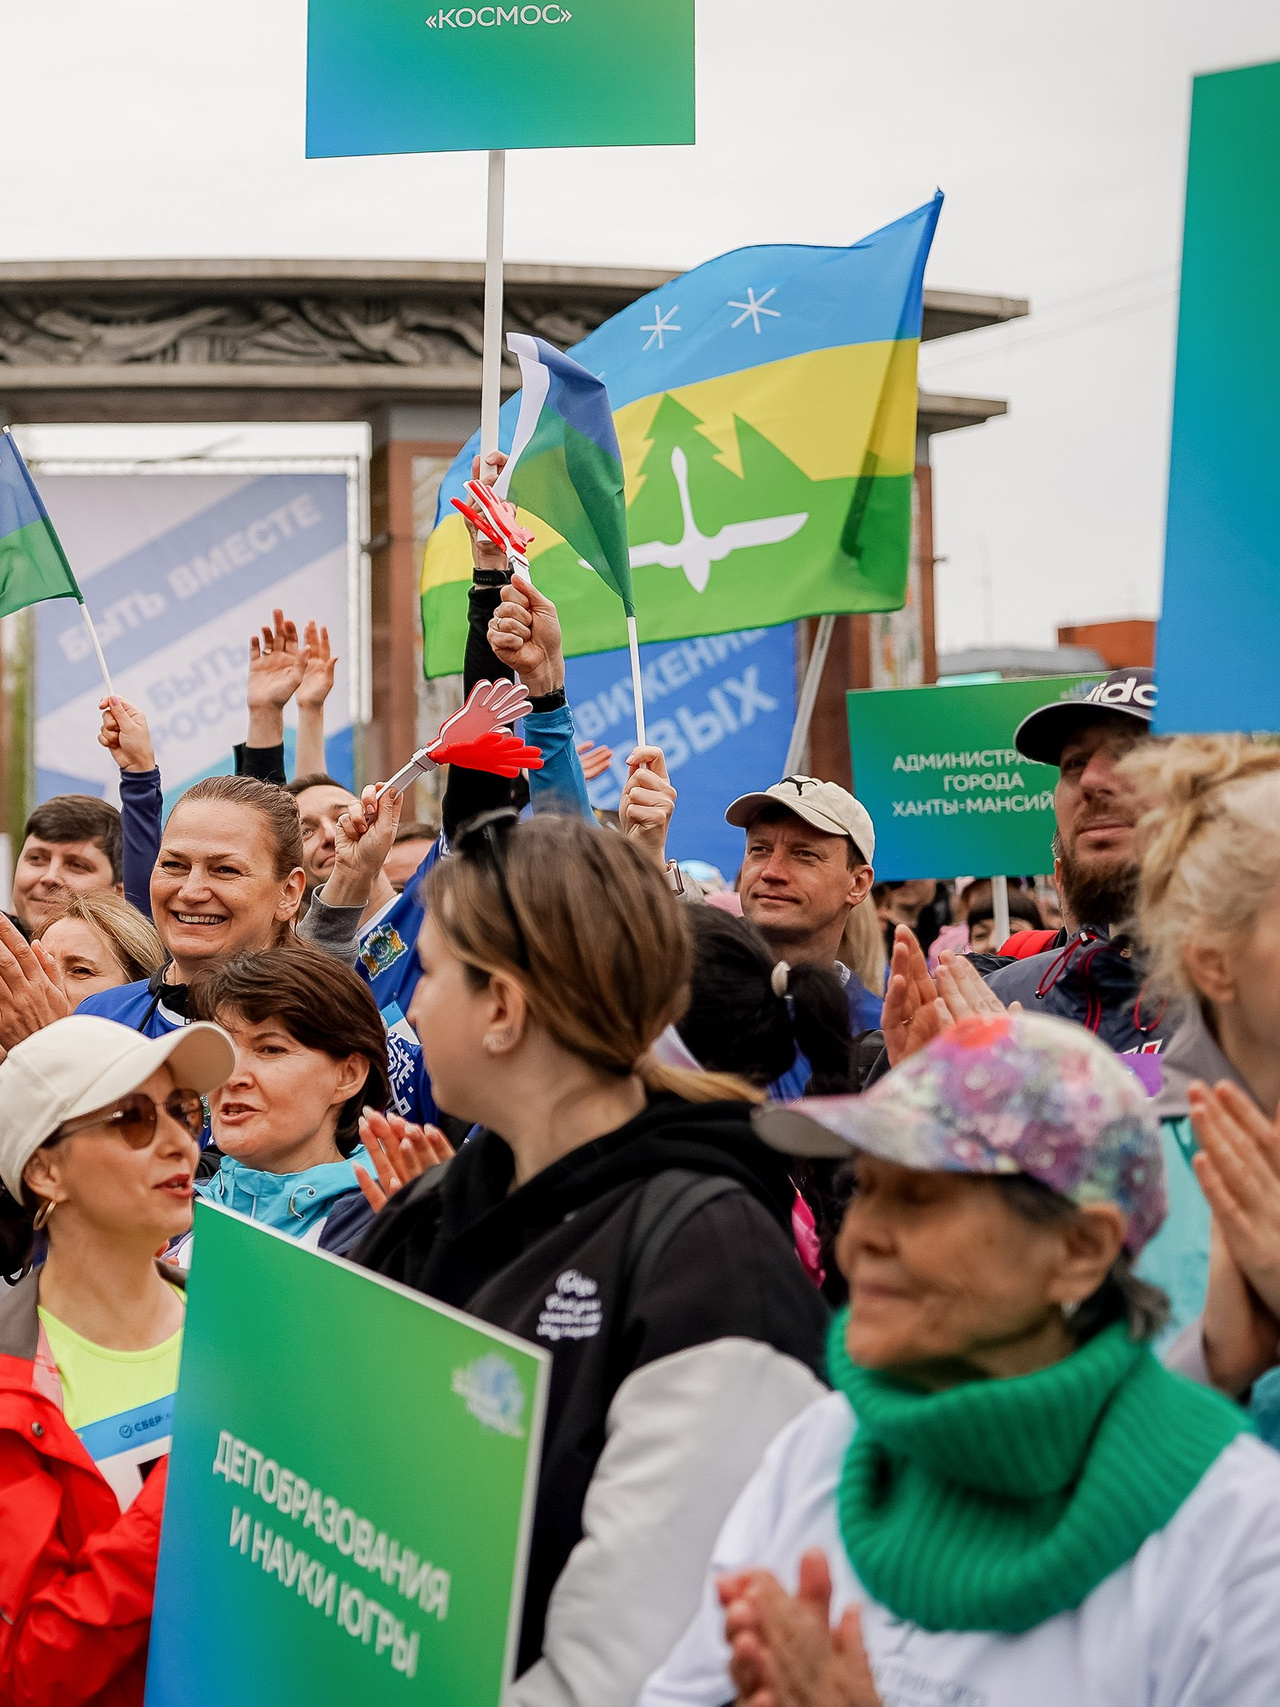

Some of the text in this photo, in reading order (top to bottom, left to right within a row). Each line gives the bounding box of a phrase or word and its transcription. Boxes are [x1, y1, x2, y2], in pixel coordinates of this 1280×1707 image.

[425, 4, 572, 29] «КОСМОС»
[166, 493, 323, 600] ВМЕСТЕ
[573, 628, 768, 742] ВИЖЕНИ
[943, 771, 1025, 792] ГОРОДА
[134, 1415, 162, 1432] СБЕР
[212, 1429, 451, 1621] ДЕПОБРАЗОВАНИЯ
[251, 1521, 337, 1617] НАУКИ
[337, 1580, 419, 1680] ЮГРЫ
